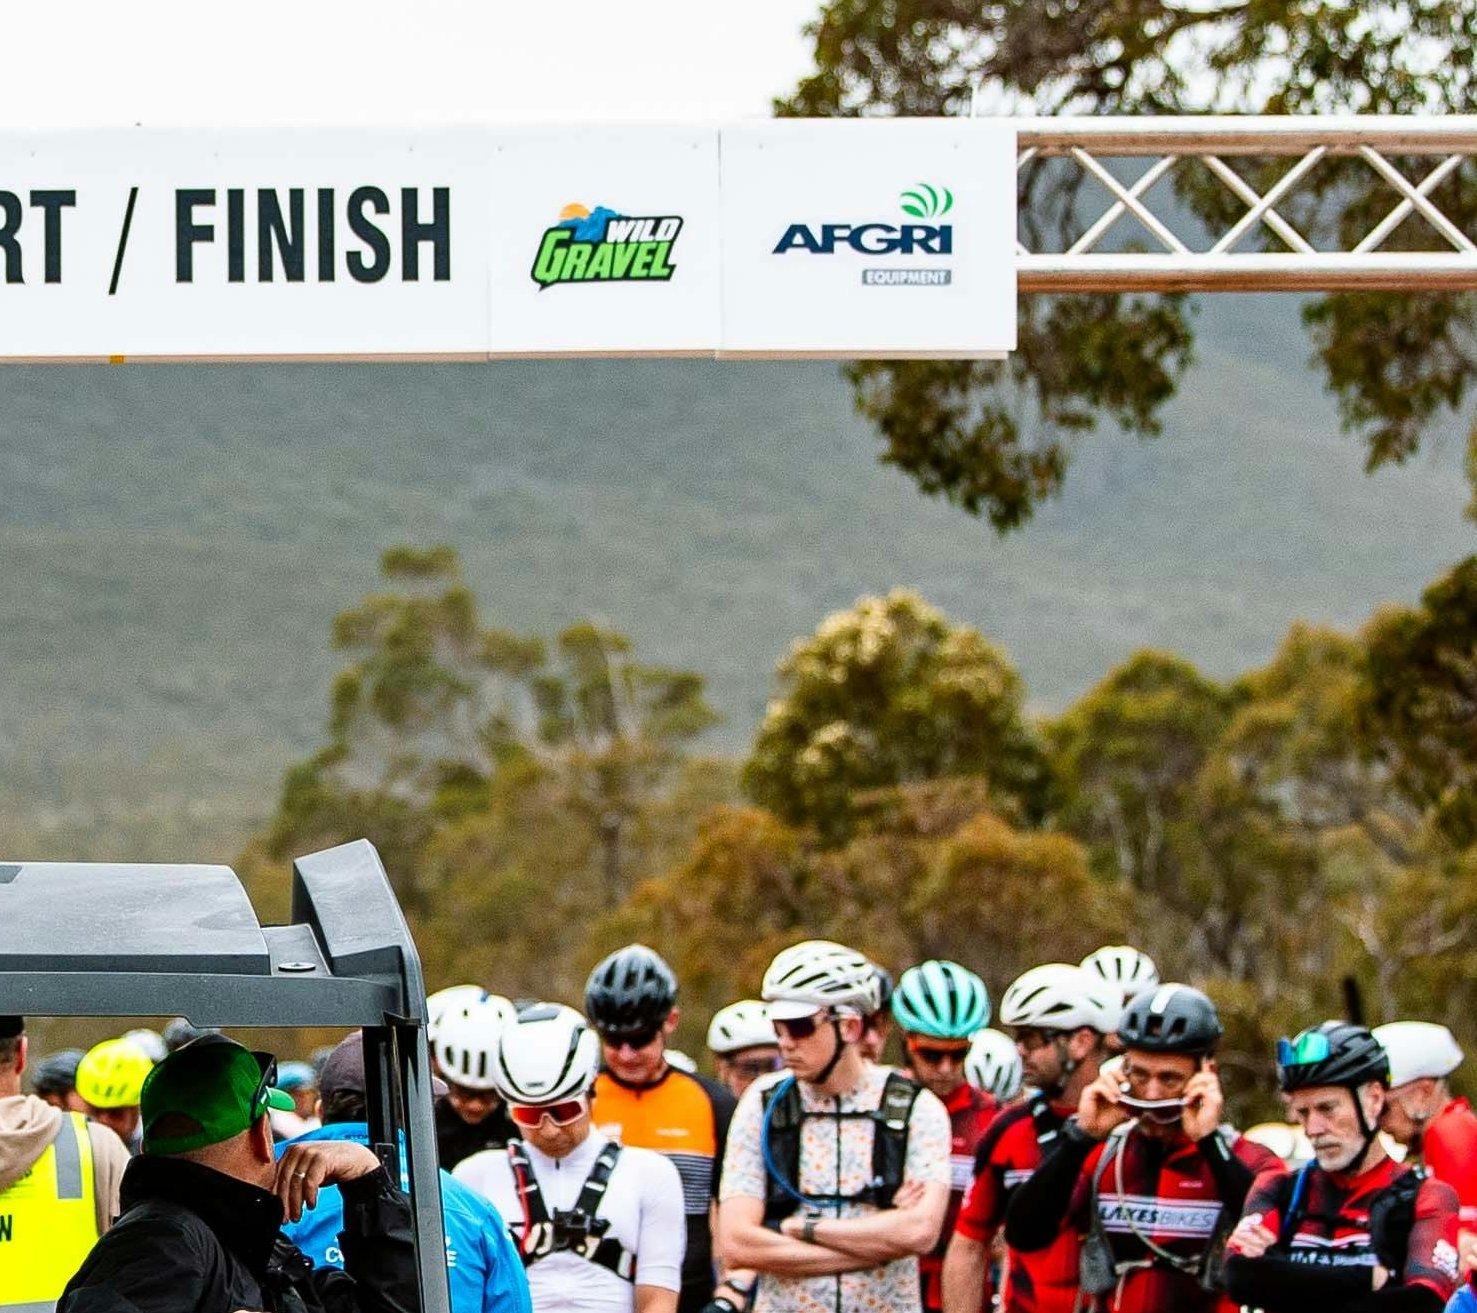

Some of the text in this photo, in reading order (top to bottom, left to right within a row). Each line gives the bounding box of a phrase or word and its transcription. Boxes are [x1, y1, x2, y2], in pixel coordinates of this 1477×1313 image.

[107, 186, 140, 296] /
[174, 185, 452, 284] FINISH
[606, 218, 681, 243] WILD
[772, 223, 953, 255] AFGRI
[533, 230, 672, 283] GRAVEL
[866, 271, 948, 285] EQUIPMENT
